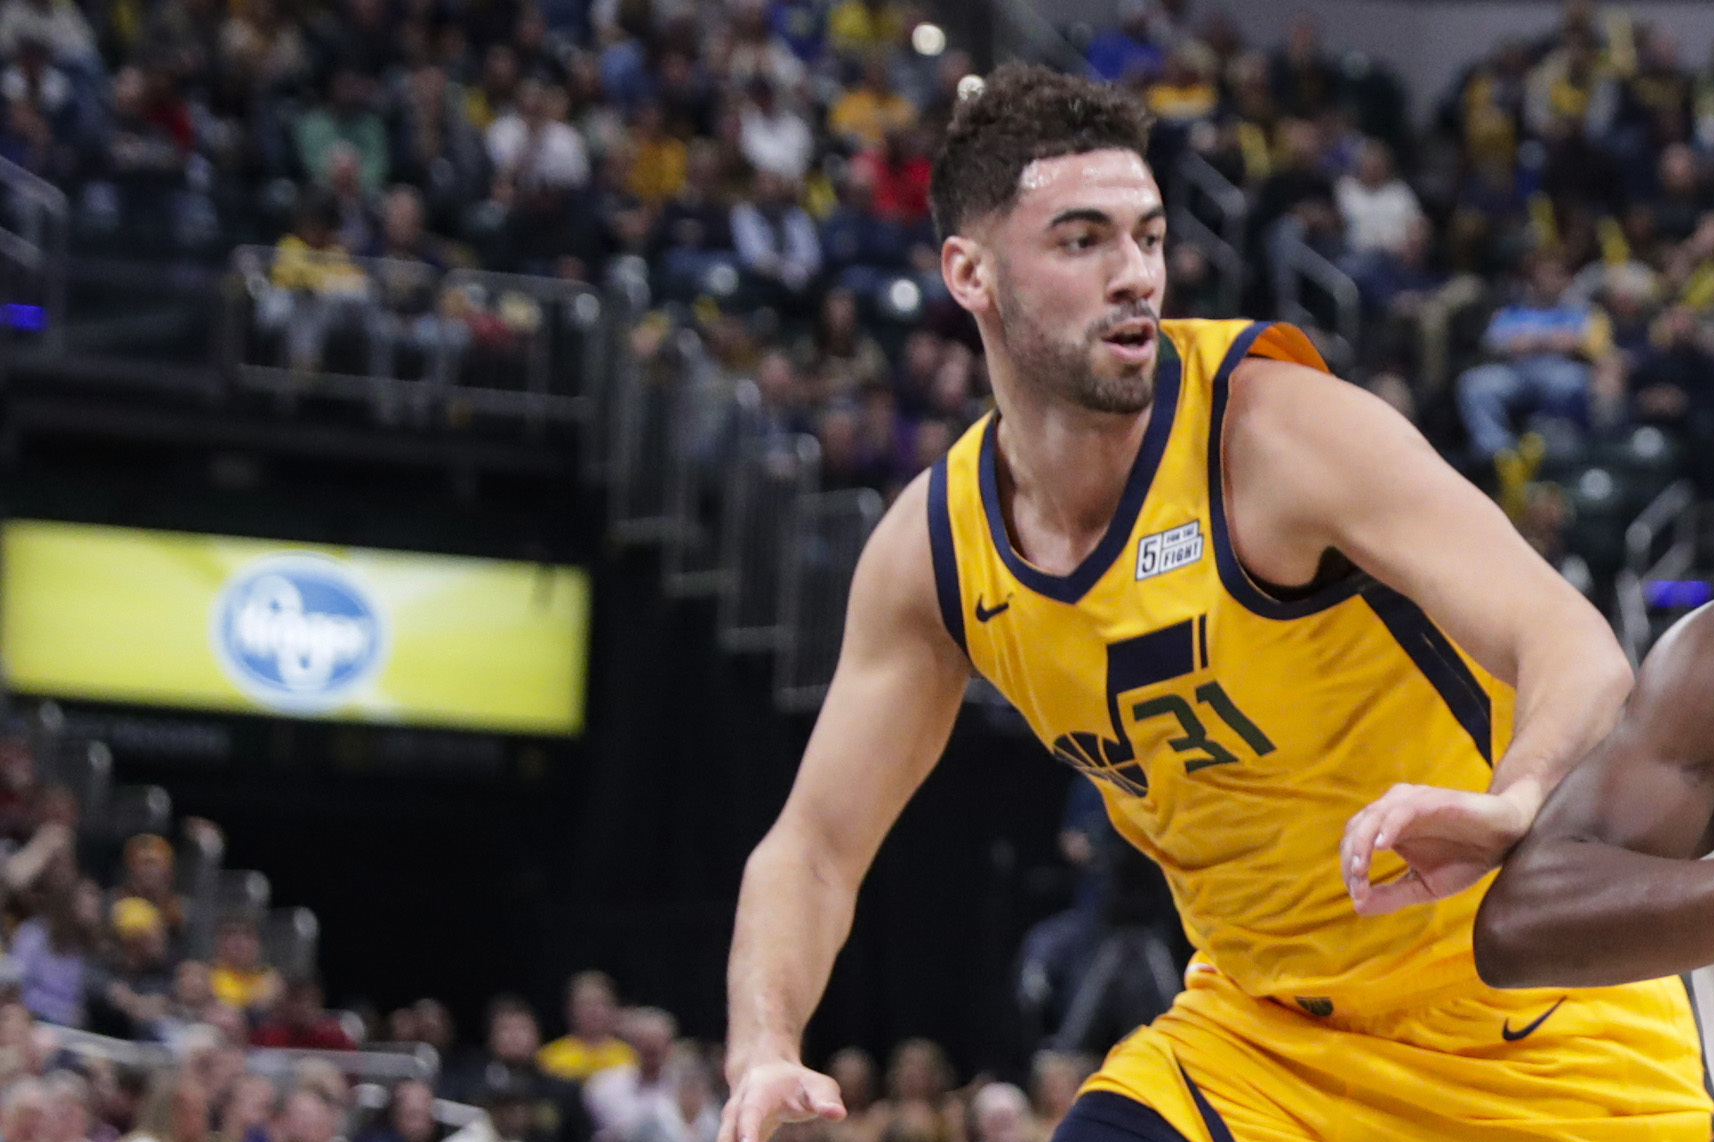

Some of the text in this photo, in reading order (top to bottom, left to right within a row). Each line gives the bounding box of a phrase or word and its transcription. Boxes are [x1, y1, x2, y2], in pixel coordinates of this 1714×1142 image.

[1141, 539, 1158, 573] 5
[1163, 540, 1199, 567] FIGHT
[1132, 679, 1278, 775] 31
